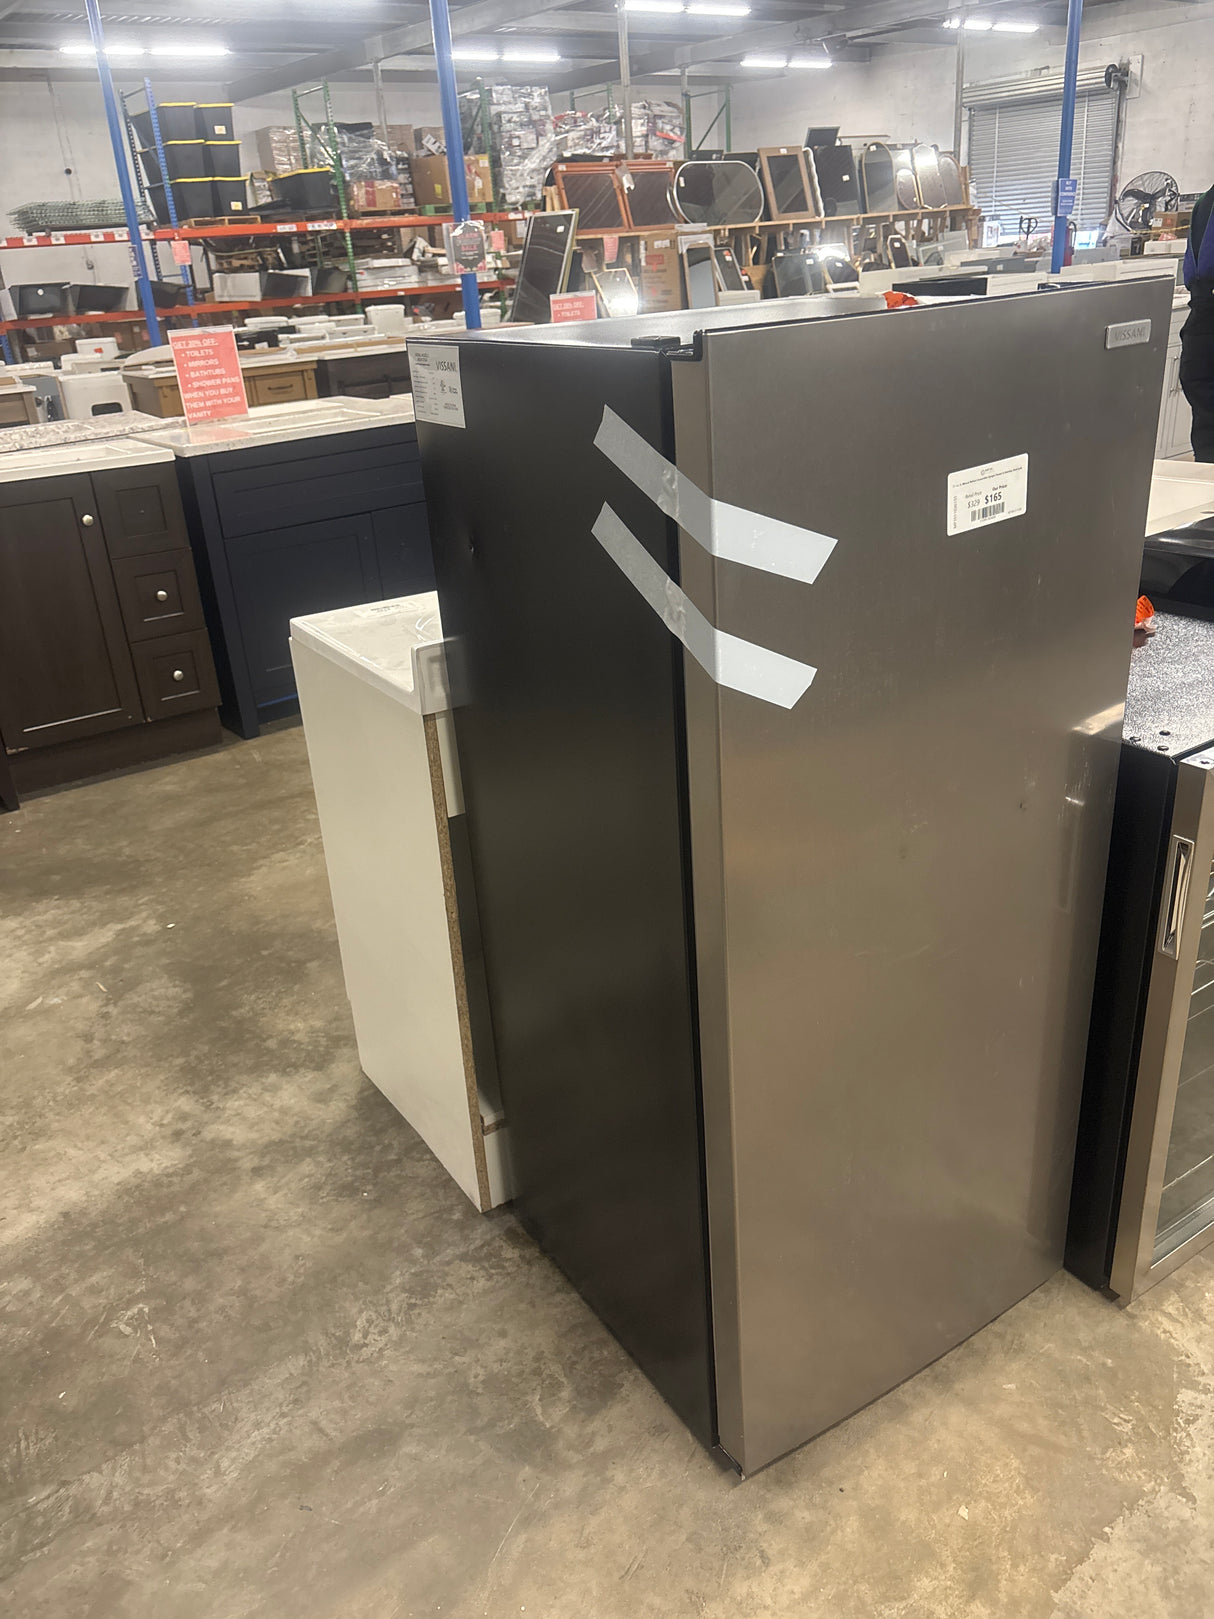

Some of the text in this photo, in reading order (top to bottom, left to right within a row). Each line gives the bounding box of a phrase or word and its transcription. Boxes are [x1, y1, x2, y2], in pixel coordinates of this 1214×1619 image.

[173, 341, 187, 349] GET
[186, 349, 214, 357] TOILETS
[188, 358, 219, 367] MIRRORS
[190, 368, 226, 378] BATHTUBS
[192, 376, 241, 388] SHOWER PANS
[184, 390, 205, 399] WHEN
[220, 387, 233, 395] BUY
[186, 401, 205, 409] THEM
[223, 396, 241, 404] YOUR
[188, 410, 212, 419] VANITY
[984, 491, 1002, 504] $165
[967, 499, 980, 509] $329
